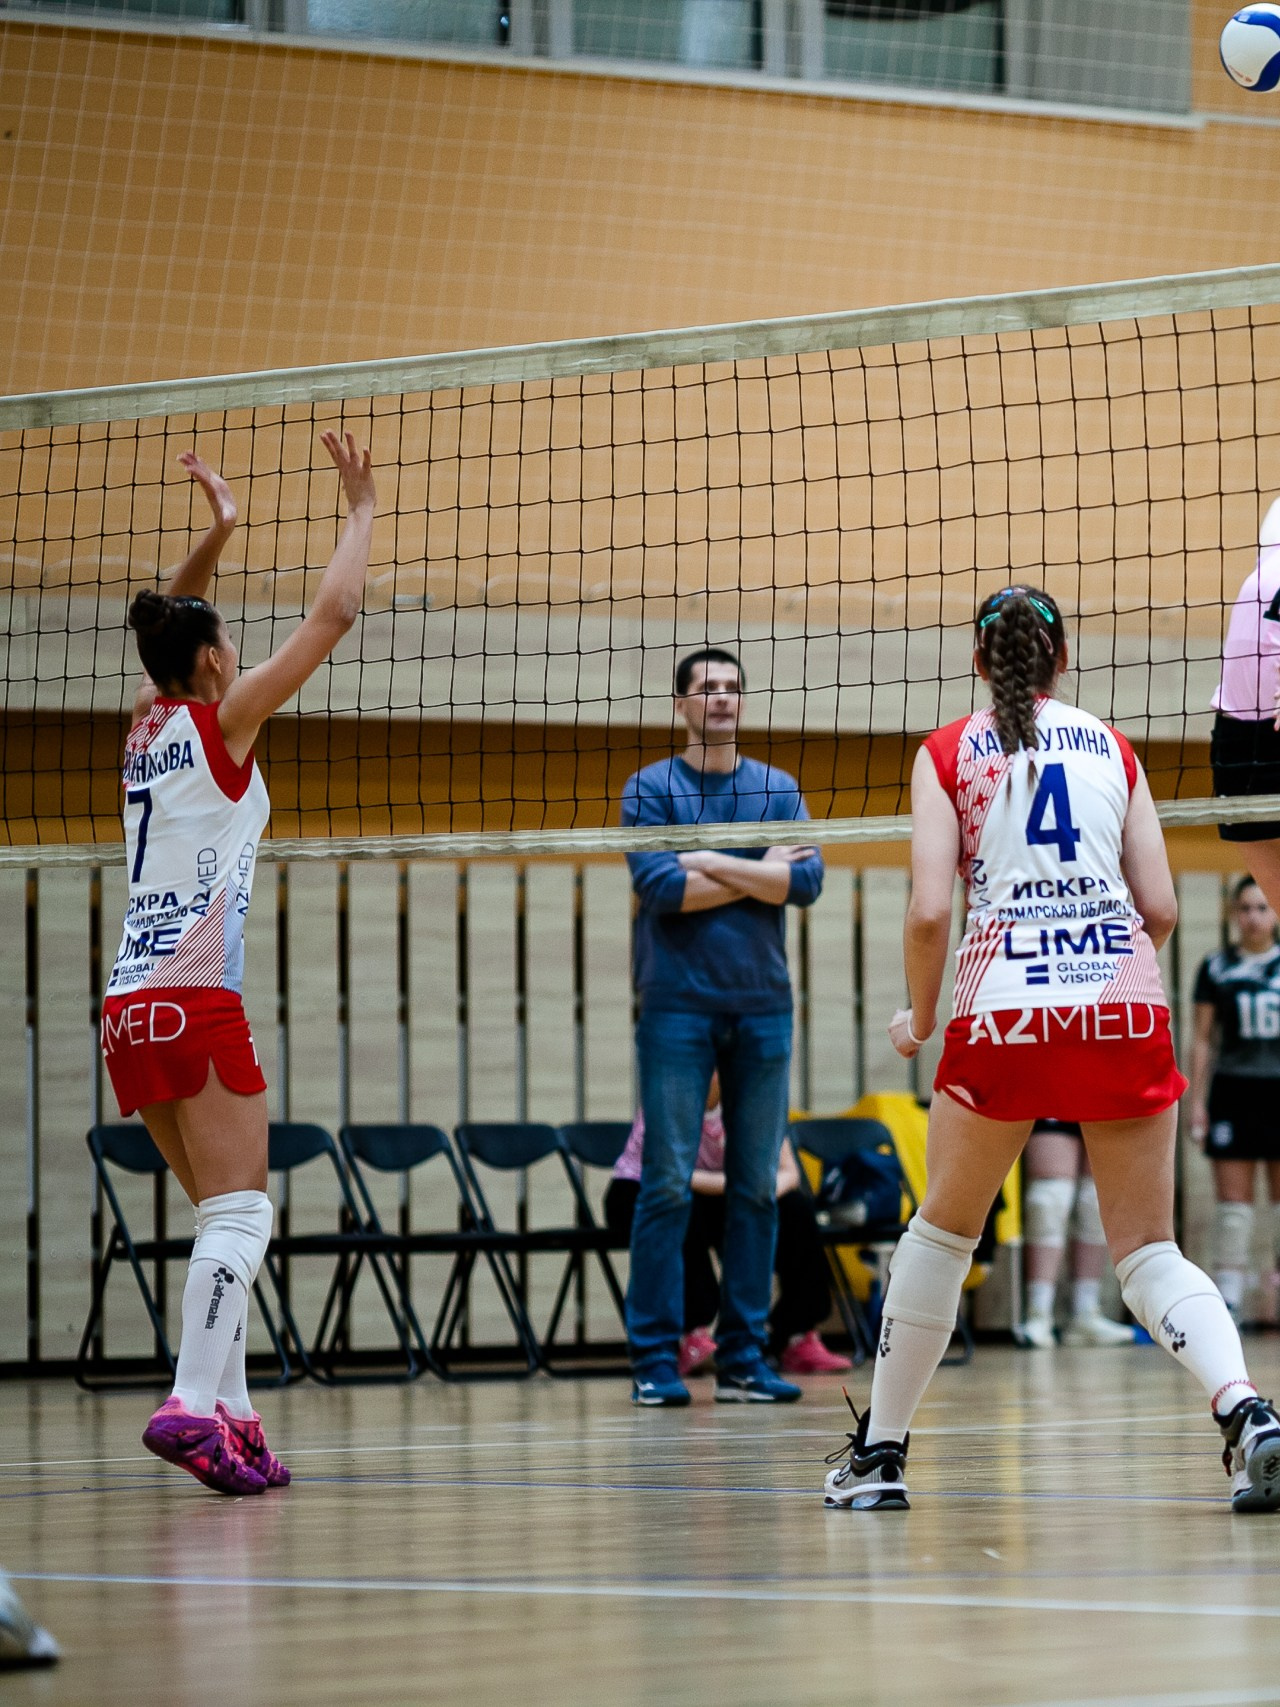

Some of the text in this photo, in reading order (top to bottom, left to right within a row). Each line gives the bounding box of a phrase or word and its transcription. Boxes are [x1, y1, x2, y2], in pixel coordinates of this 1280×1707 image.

[968, 726, 1111, 759] ХАУЛИНА
[1025, 762, 1081, 862] 4
[127, 788, 153, 883] 7
[1012, 876, 1110, 901] ИСКРА
[127, 891, 179, 917] СКРА
[1003, 923, 1134, 961] LIME
[120, 962, 155, 975] GLOBAL
[1056, 961, 1121, 972] GLOBAL
[1058, 972, 1115, 984] VISION
[967, 1003, 1155, 1045] A2MED
